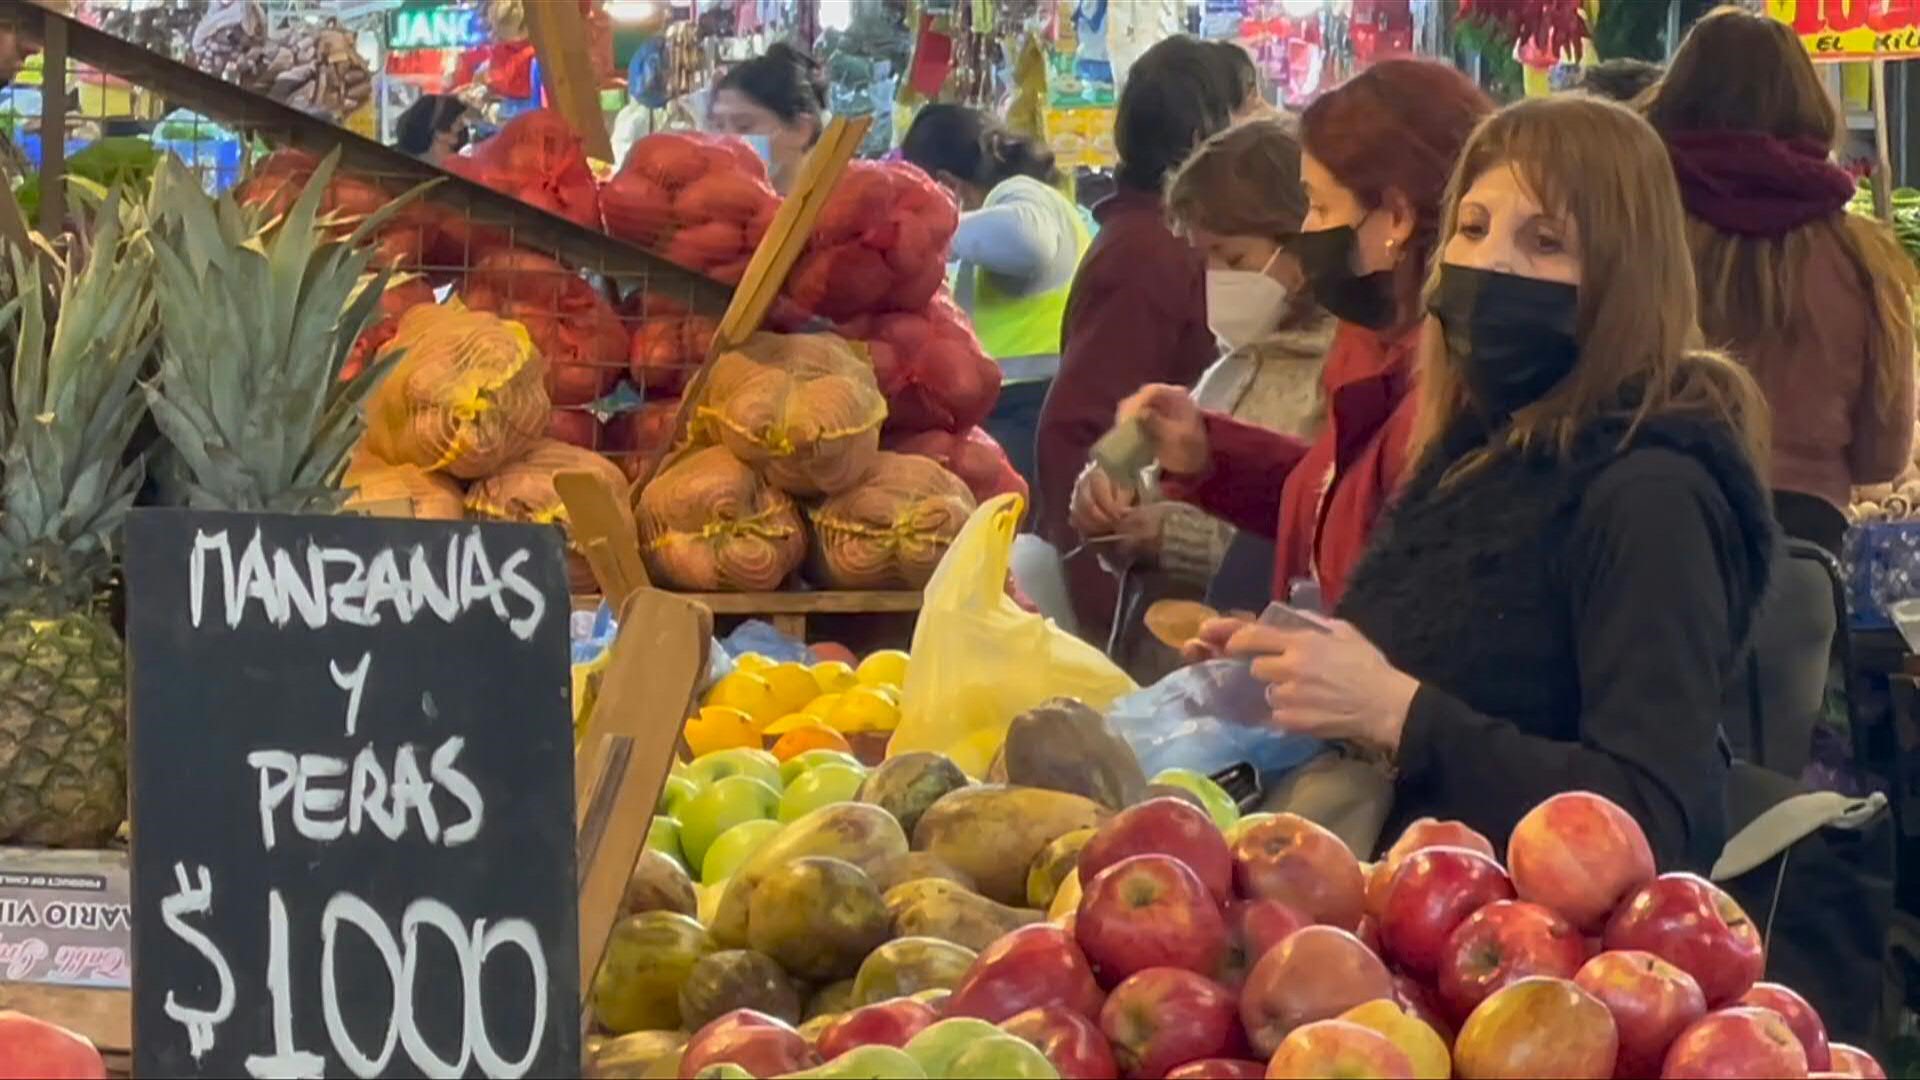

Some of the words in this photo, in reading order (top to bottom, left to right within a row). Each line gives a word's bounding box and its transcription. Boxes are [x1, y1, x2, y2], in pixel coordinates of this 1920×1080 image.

[1816, 35, 1844, 51] EL
[190, 525, 546, 640] MANZANAS
[330, 652, 371, 736] Y
[247, 736, 484, 848] PERAS
[161, 861, 548, 1080] $1000
